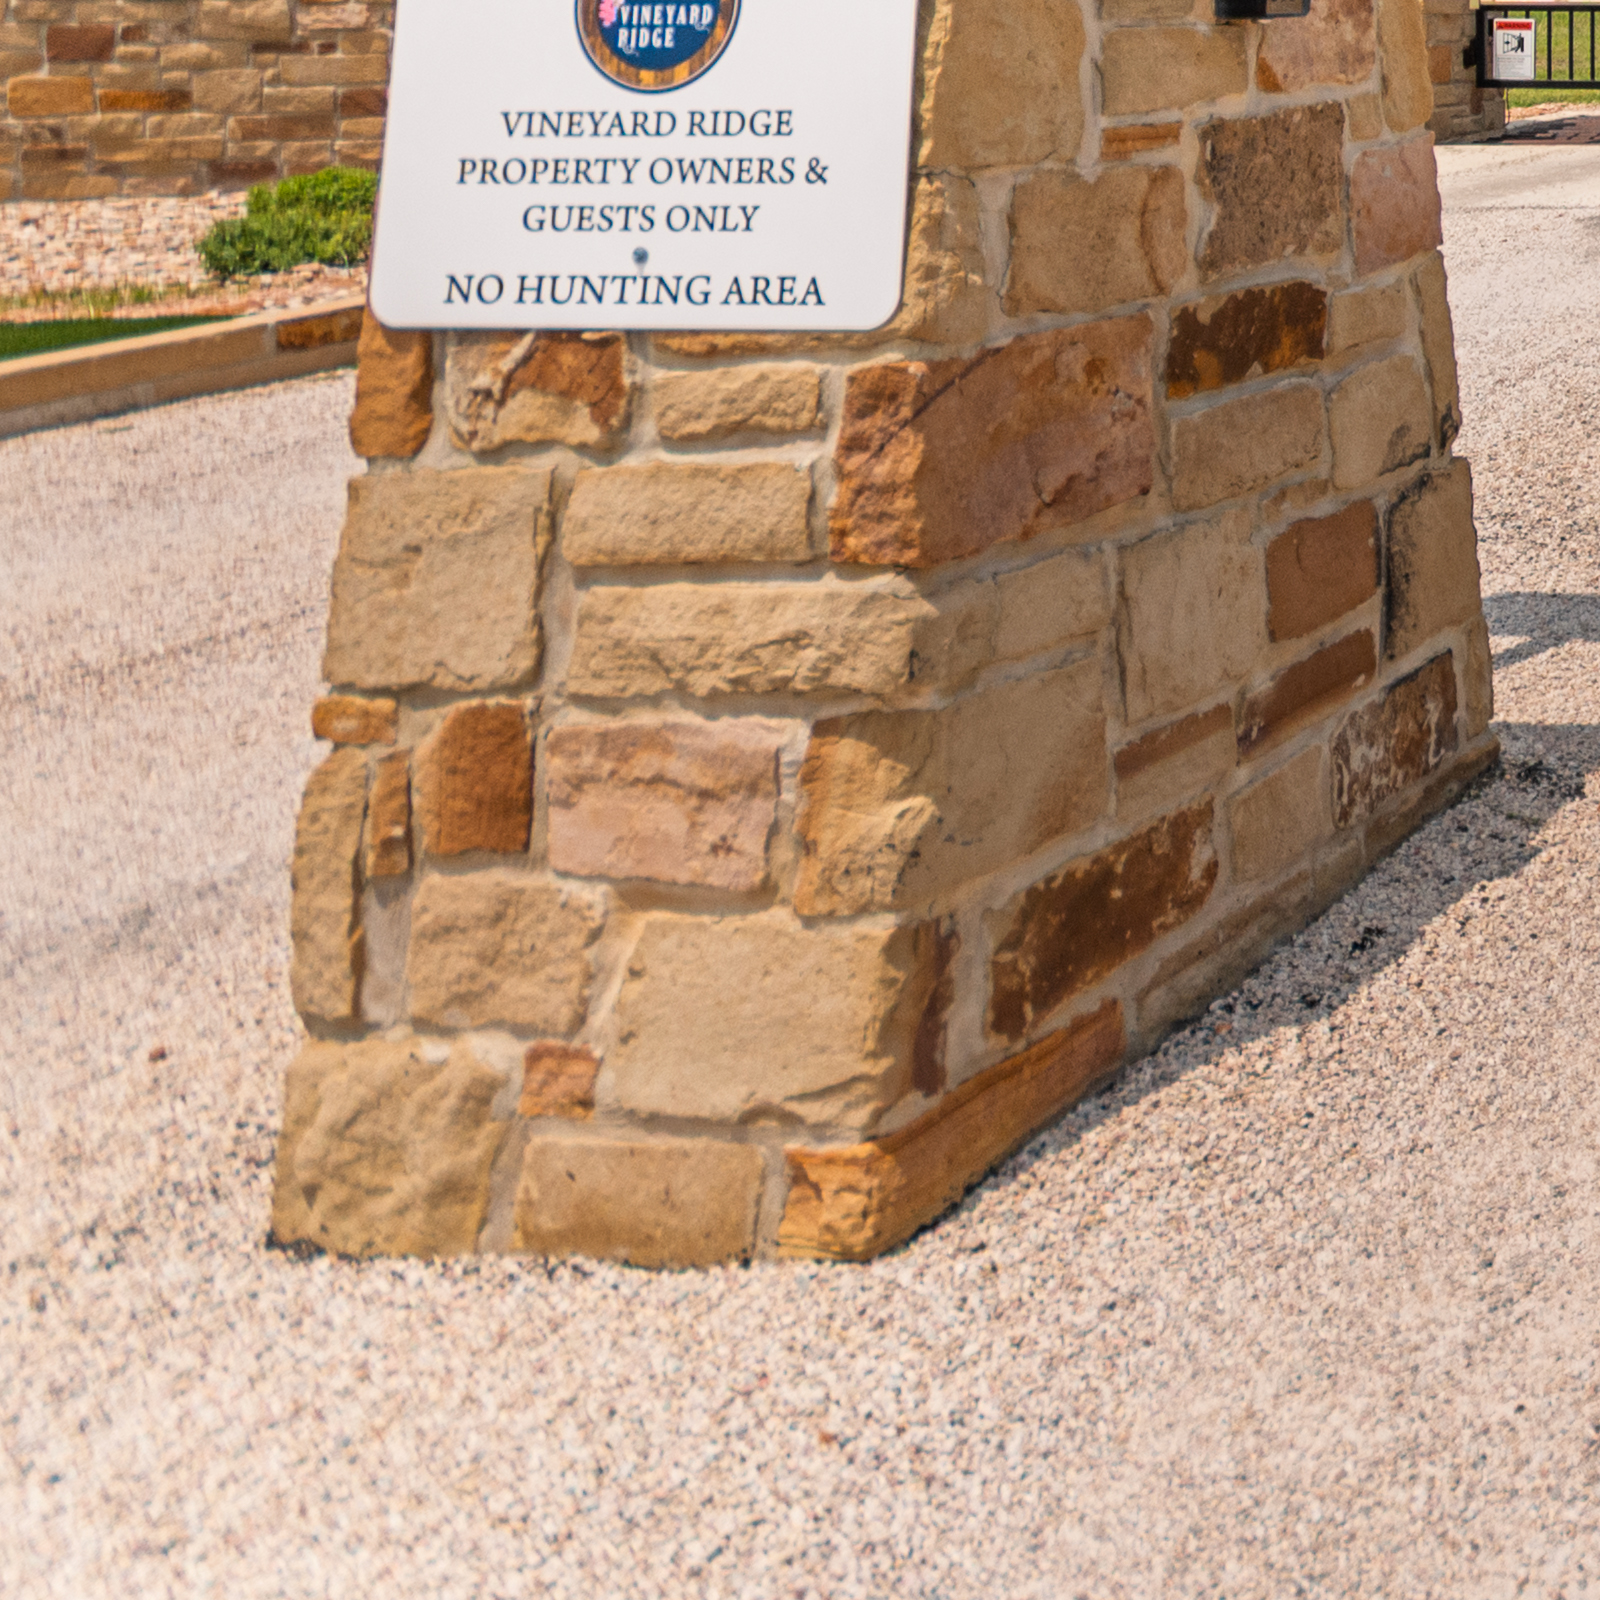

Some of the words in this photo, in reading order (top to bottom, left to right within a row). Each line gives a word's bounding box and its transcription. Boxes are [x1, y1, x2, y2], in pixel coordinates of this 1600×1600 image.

[620, 4, 713, 32] VINEYARD
[618, 27, 675, 56] RIDGE
[502, 111, 676, 136] VINEYARD
[687, 110, 792, 136] RIDGE
[459, 159, 640, 184] PROPERTY
[649, 158, 794, 184] OWNERS
[805, 157, 828, 184] &
[523, 206, 655, 232] GUESTS
[666, 206, 759, 232] ONLY
[445, 275, 503, 304] NO
[516, 275, 710, 305] HUNTING
[721, 276, 825, 305] AREA
